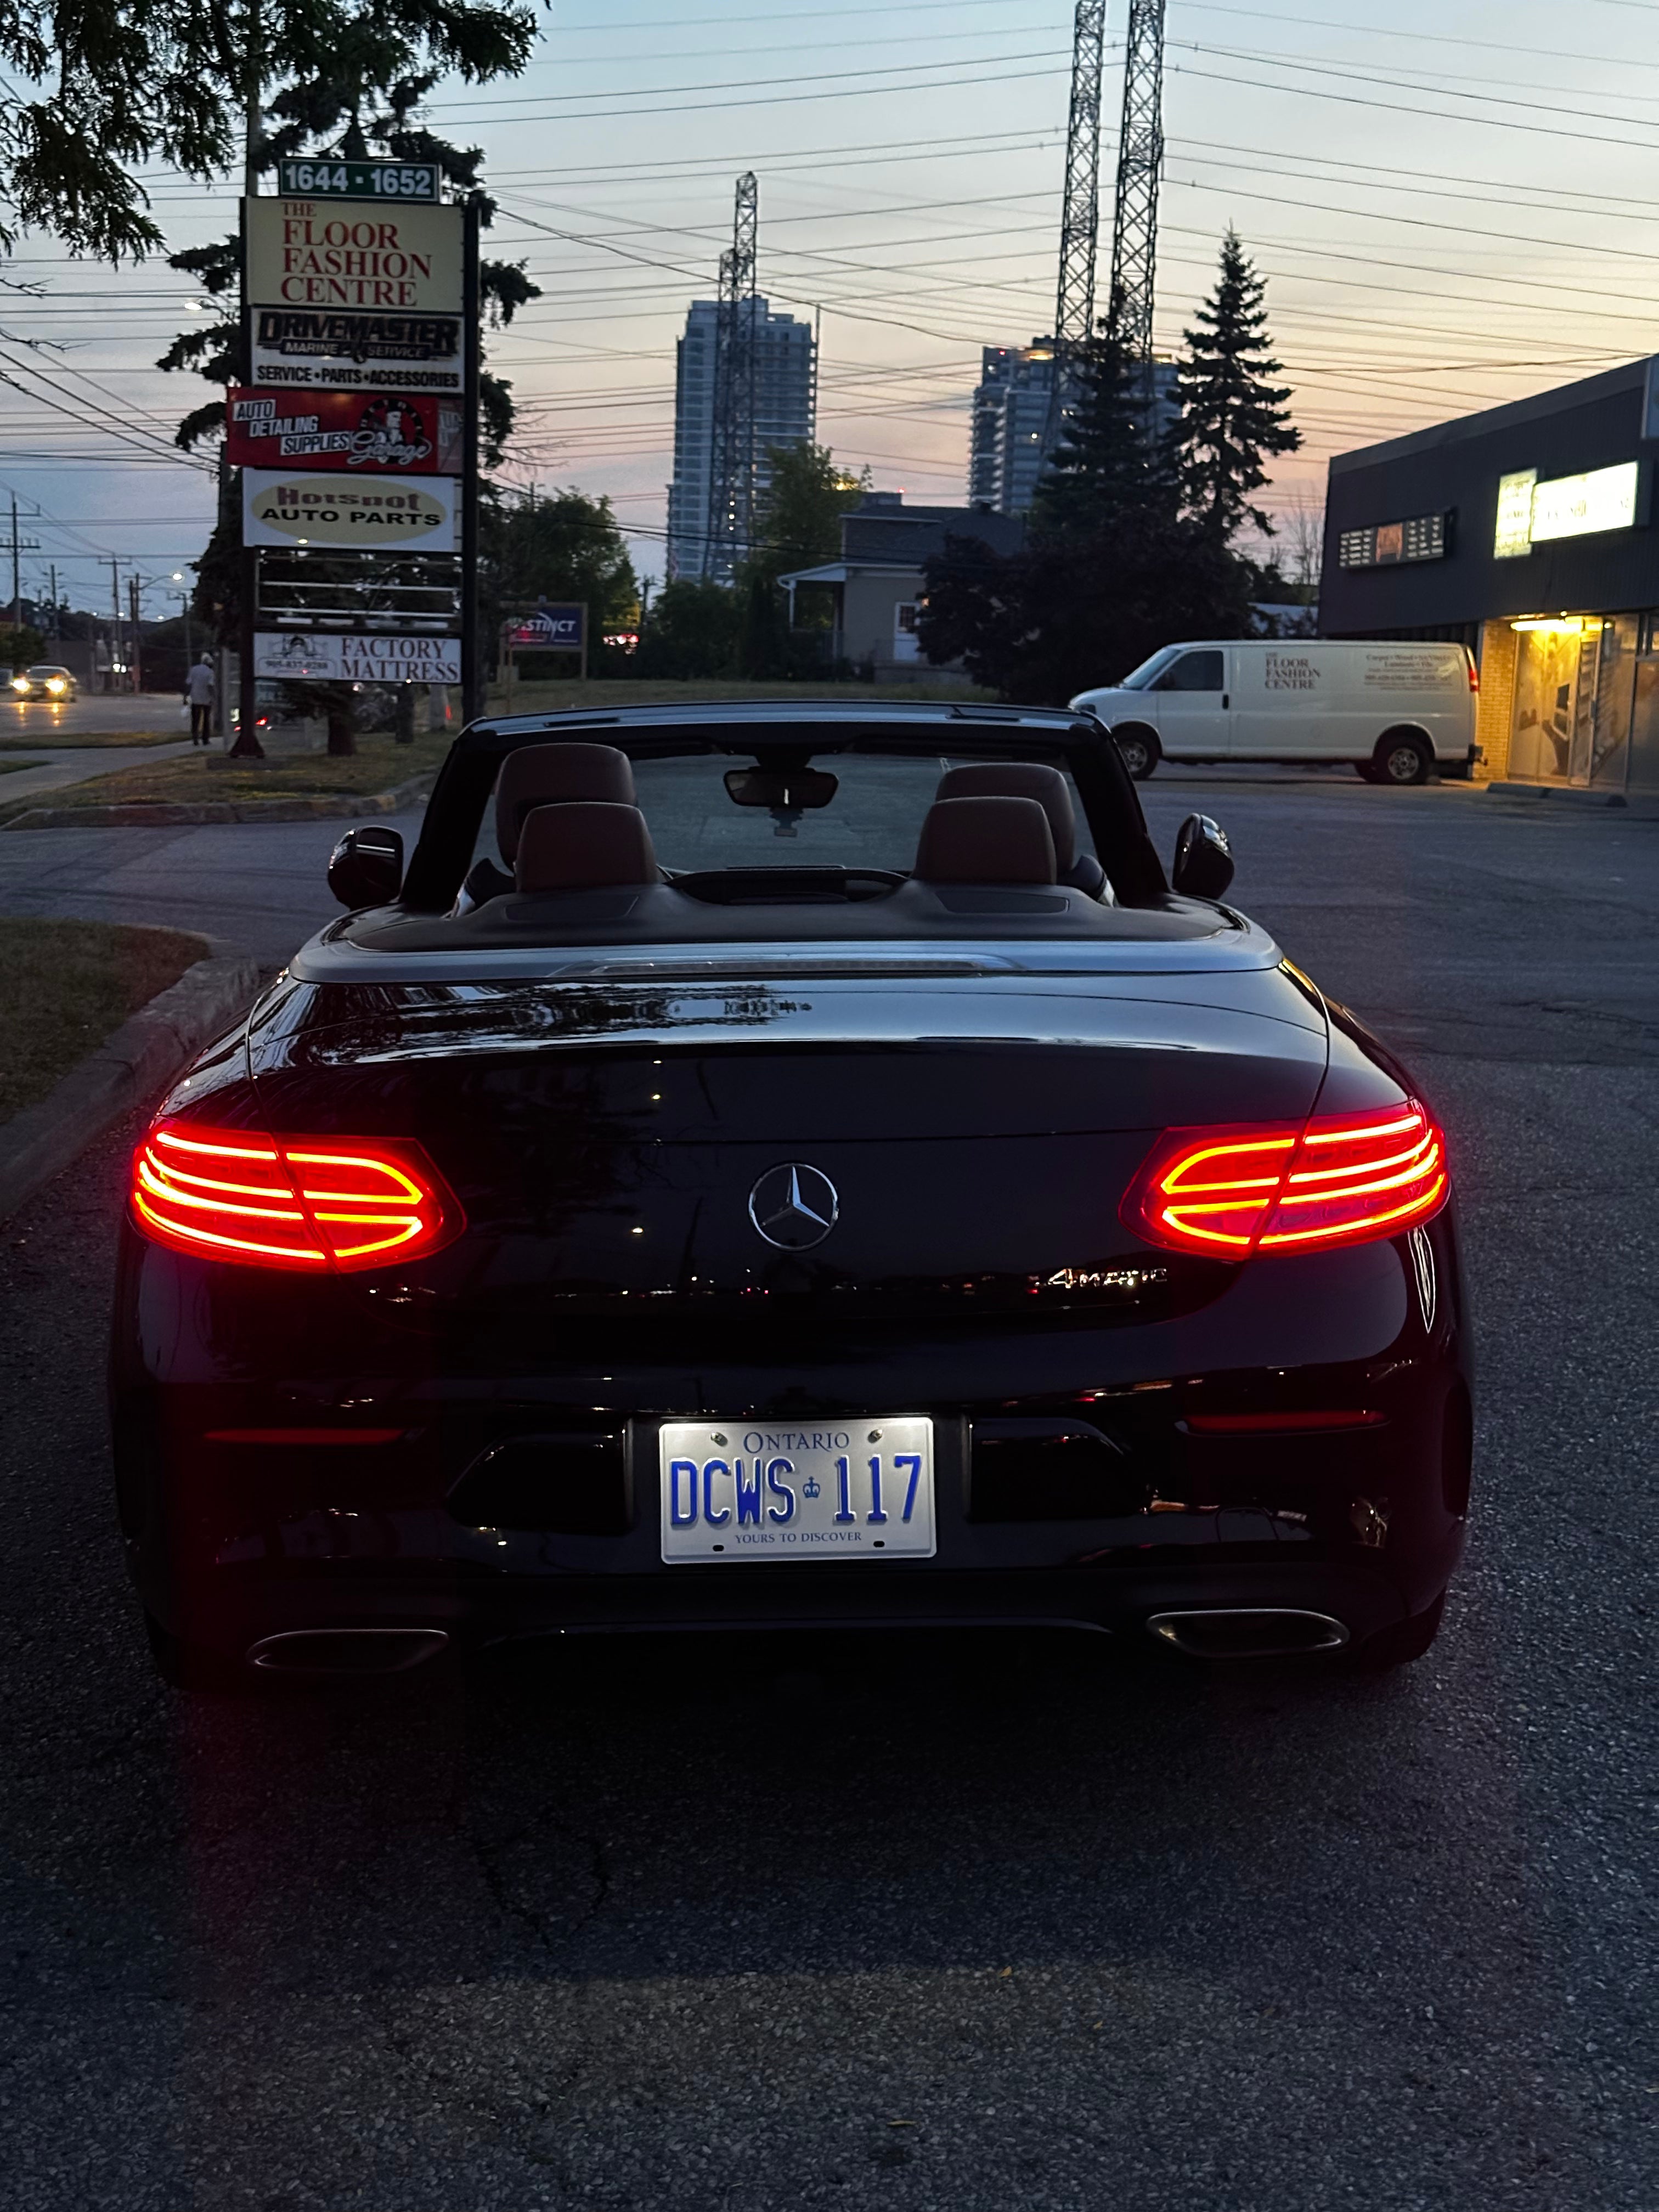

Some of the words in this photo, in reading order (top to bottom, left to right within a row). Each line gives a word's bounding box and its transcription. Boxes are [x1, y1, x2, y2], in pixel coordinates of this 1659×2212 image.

[285, 165, 348, 191] 1644
[371, 168, 431, 194] 1652
[281, 202, 317, 217] THE
[284, 220, 399, 248] FLOOR
[284, 249, 432, 279] FASHION
[281, 278, 417, 306] CENTRE
[258, 313, 460, 353] DRIVEMASTER
[284, 342, 338, 354] MARINE
[367, 346, 425, 358] SERVICE
[257, 365, 312, 381] SERVICE
[236, 402, 273, 420] AUTO
[250, 417, 318, 437] DETAILING
[283, 435, 349, 455] SUPPLIES
[347, 430, 432, 465] Garage
[262, 508, 338, 522] AUTO
[351, 512, 442, 526] PARTS
[341, 637, 448, 660] FACTORY
[340, 658, 459, 681] MATTRESS
[1266, 658, 1308, 668] FLOOR
[1266, 668, 1321, 678] FASHION
[1265, 679, 1315, 689] CENTRE
[743, 1431, 850, 1454] ONTARIO
[670, 1456, 797, 1526] DCWS
[833, 1453, 922, 1522] 117
[735, 1534, 775, 1544] YOURS
[780, 1533, 797, 1543] TO
[801, 1532, 862, 1542] DISCOVER
